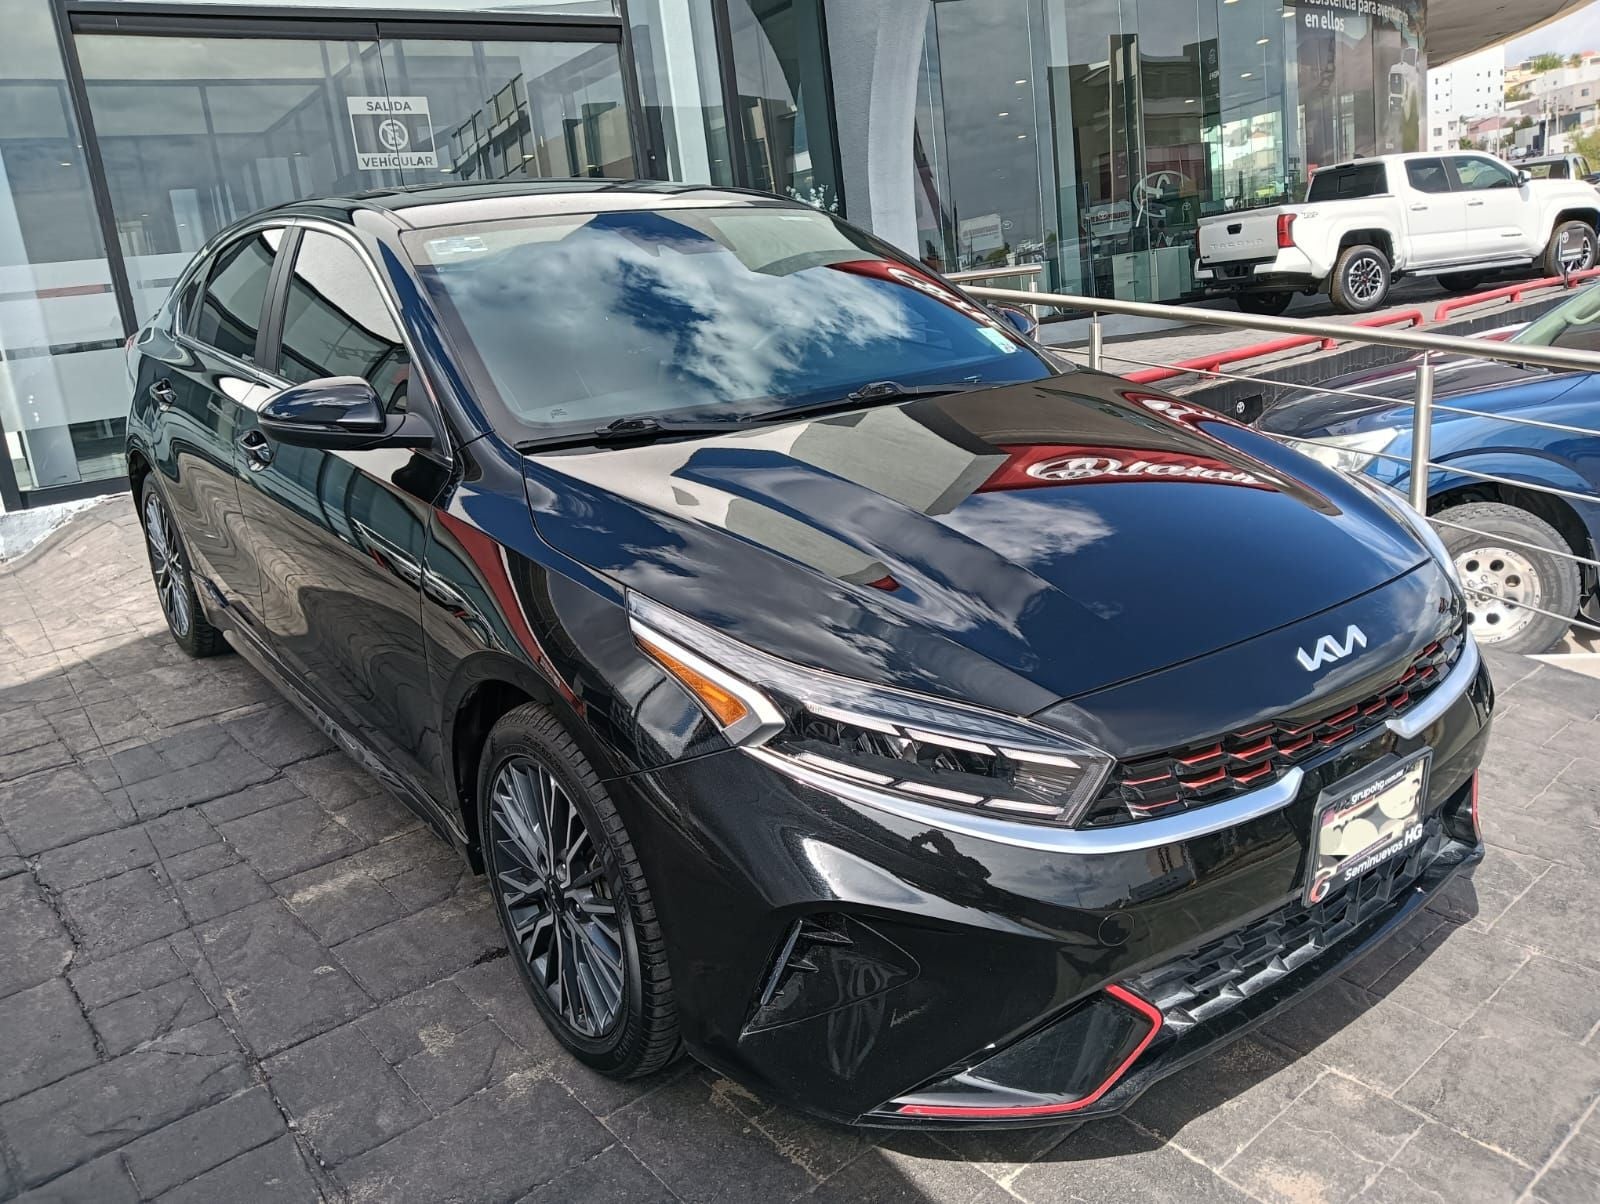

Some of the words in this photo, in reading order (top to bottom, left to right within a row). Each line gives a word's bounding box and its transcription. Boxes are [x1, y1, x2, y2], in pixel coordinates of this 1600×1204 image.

[1304, 0, 1357, 11] tencia
[1358, 0, 1377, 16] para
[1305, 13, 1319, 28] en
[1321, 10, 1345, 32] ellos
[366, 101, 412, 112] SALIDA
[1344, 839, 1404, 881] Seminuevos
[1404, 824, 1423, 847] HG
